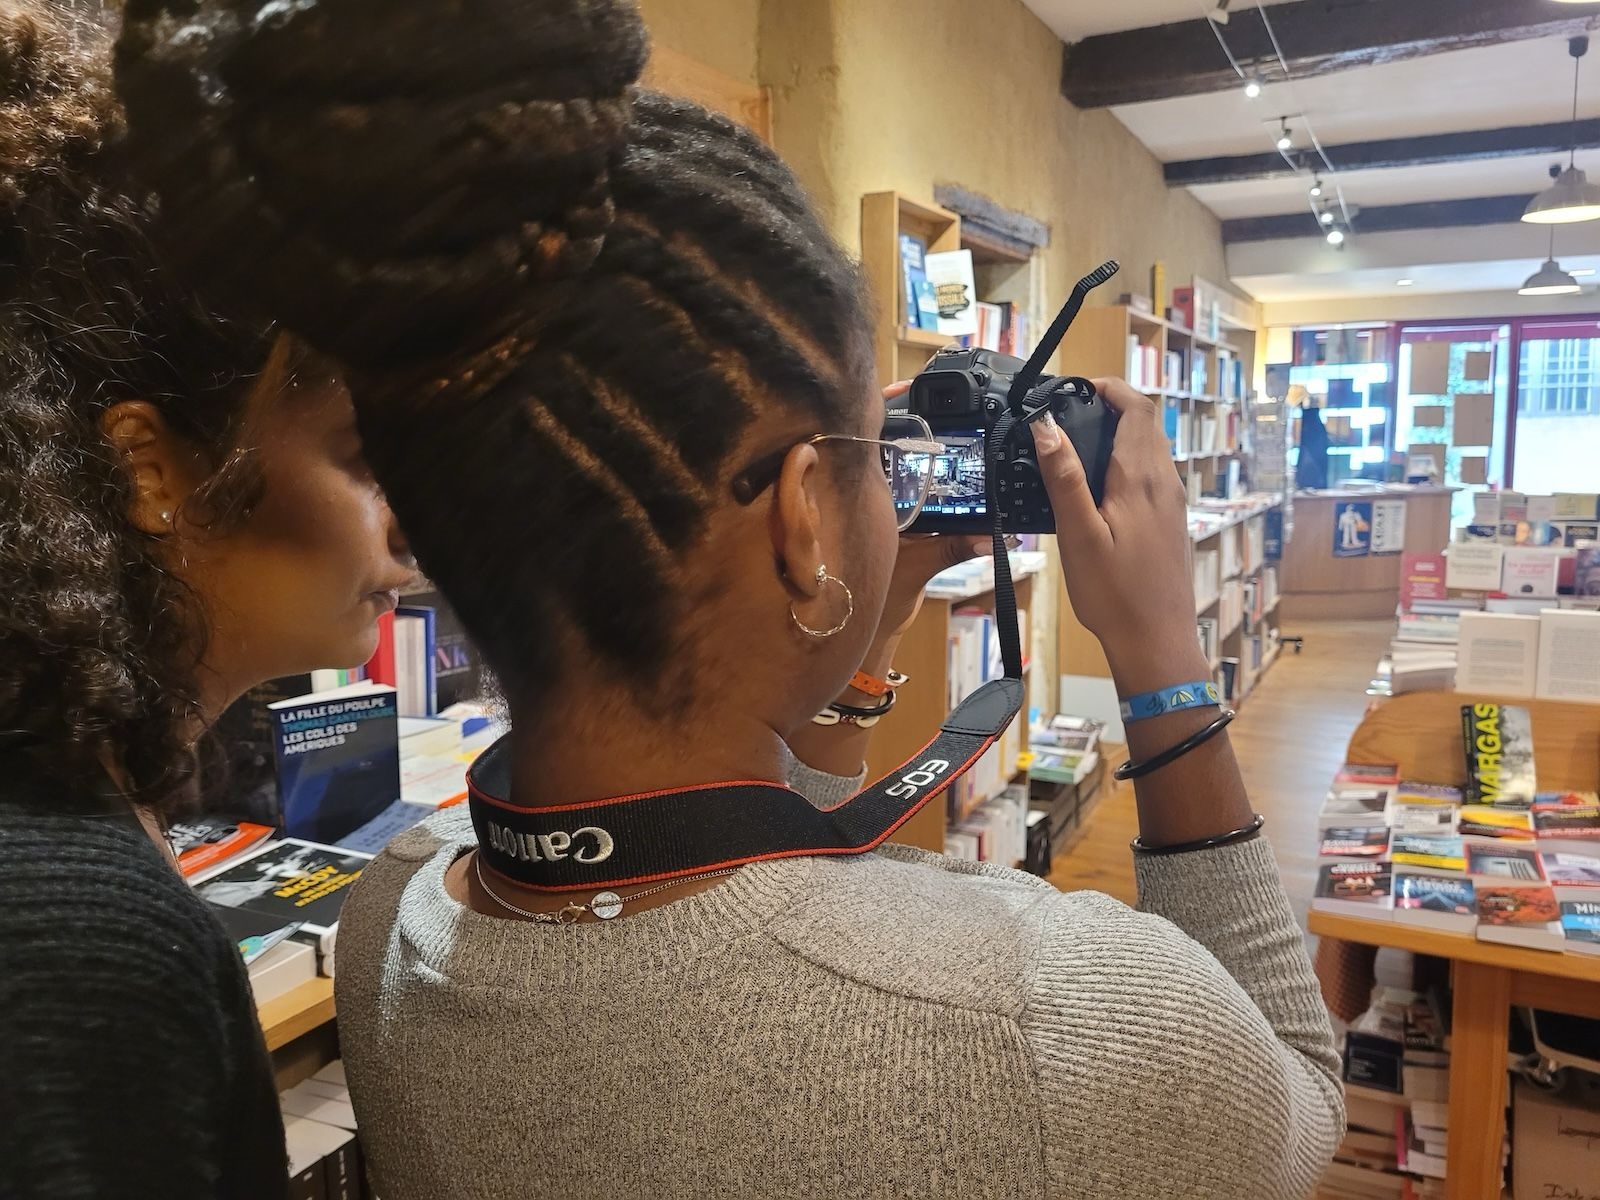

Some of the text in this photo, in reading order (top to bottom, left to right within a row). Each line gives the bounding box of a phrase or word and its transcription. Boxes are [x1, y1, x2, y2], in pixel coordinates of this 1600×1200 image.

[280, 710, 296, 723] LA
[297, 704, 328, 720] FILLE
[327, 703, 344, 715] DU
[282, 730, 304, 745] LES
[1474, 703, 1502, 803] VARGAS
[884, 758, 950, 801] EOS
[487, 823, 615, 865] Canon
